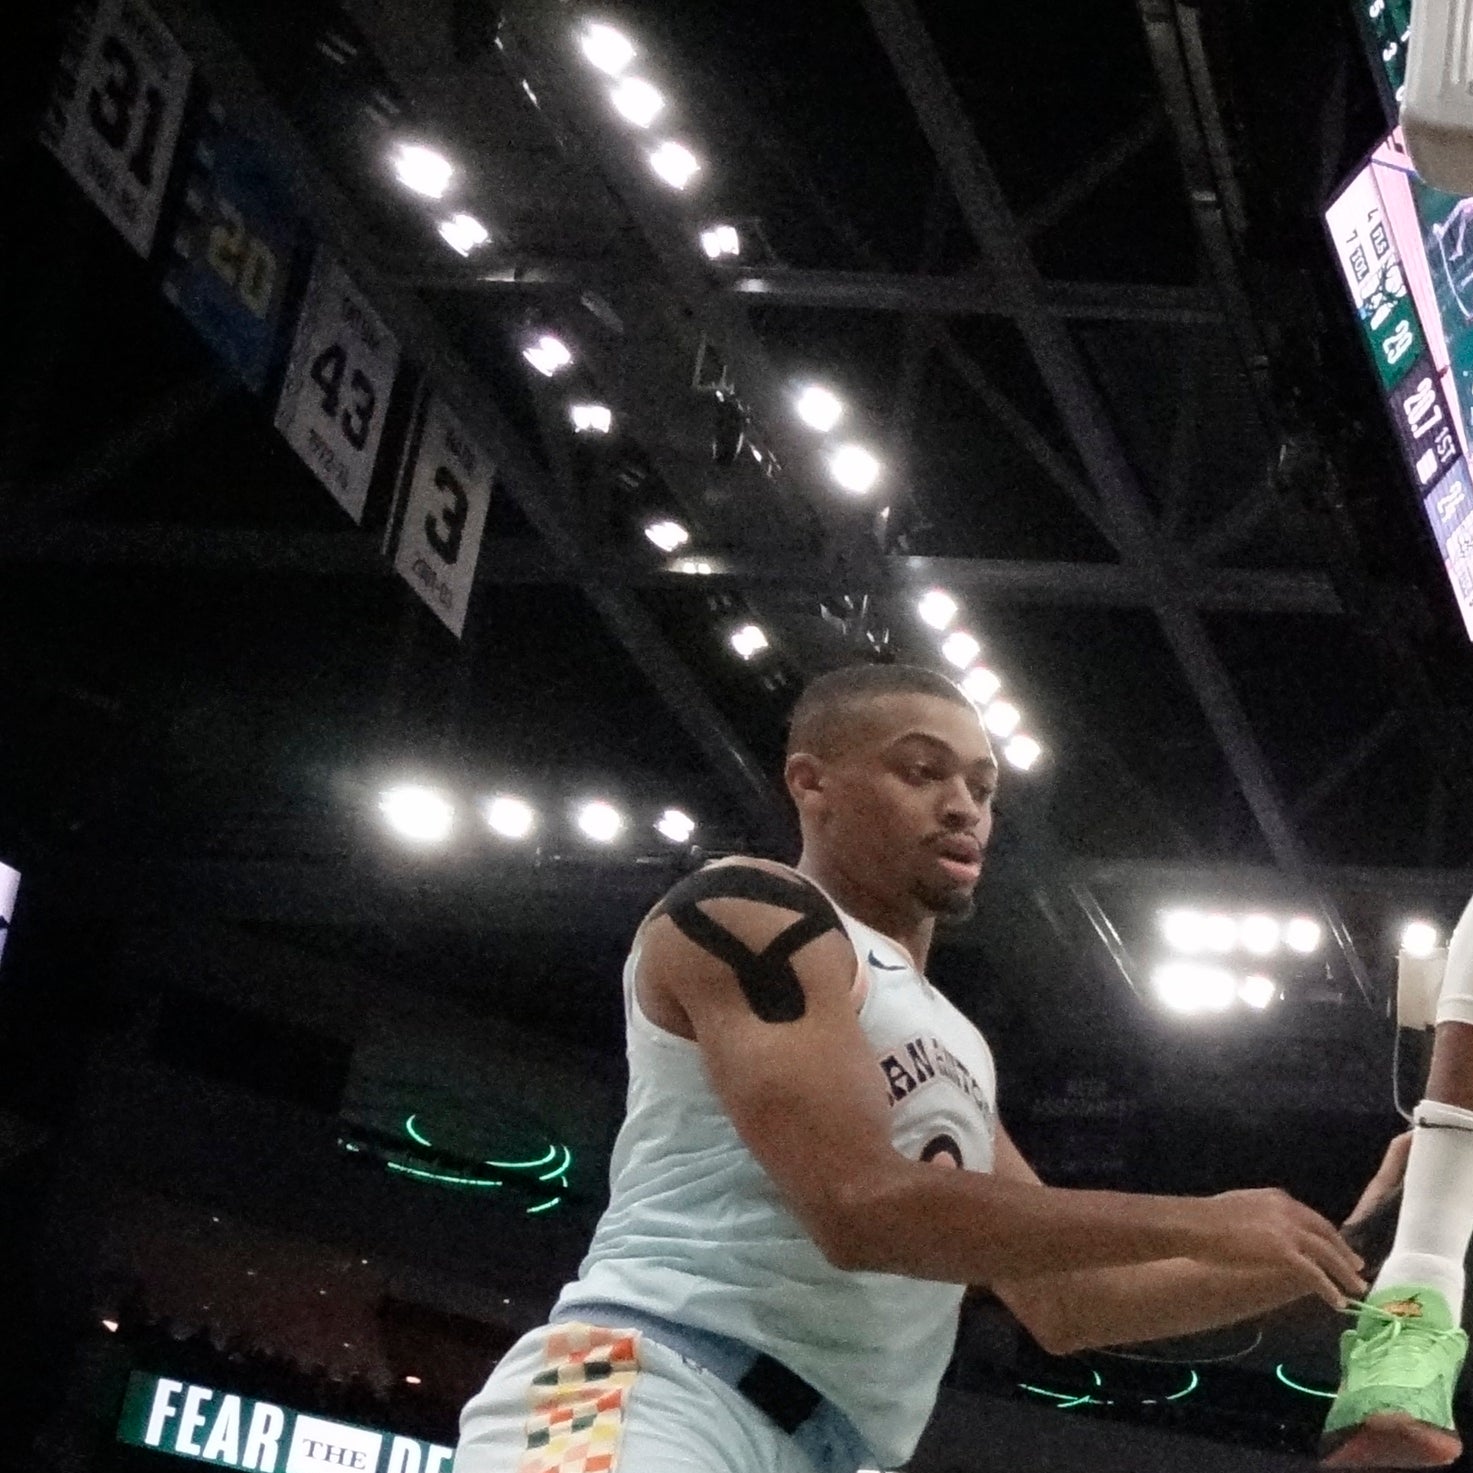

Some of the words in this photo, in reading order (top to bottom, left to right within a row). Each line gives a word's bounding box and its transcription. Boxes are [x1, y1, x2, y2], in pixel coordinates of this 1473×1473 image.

[424, 465, 468, 566] 3
[880, 1037, 935, 1107] AN
[301, 1437, 368, 1471] THE
